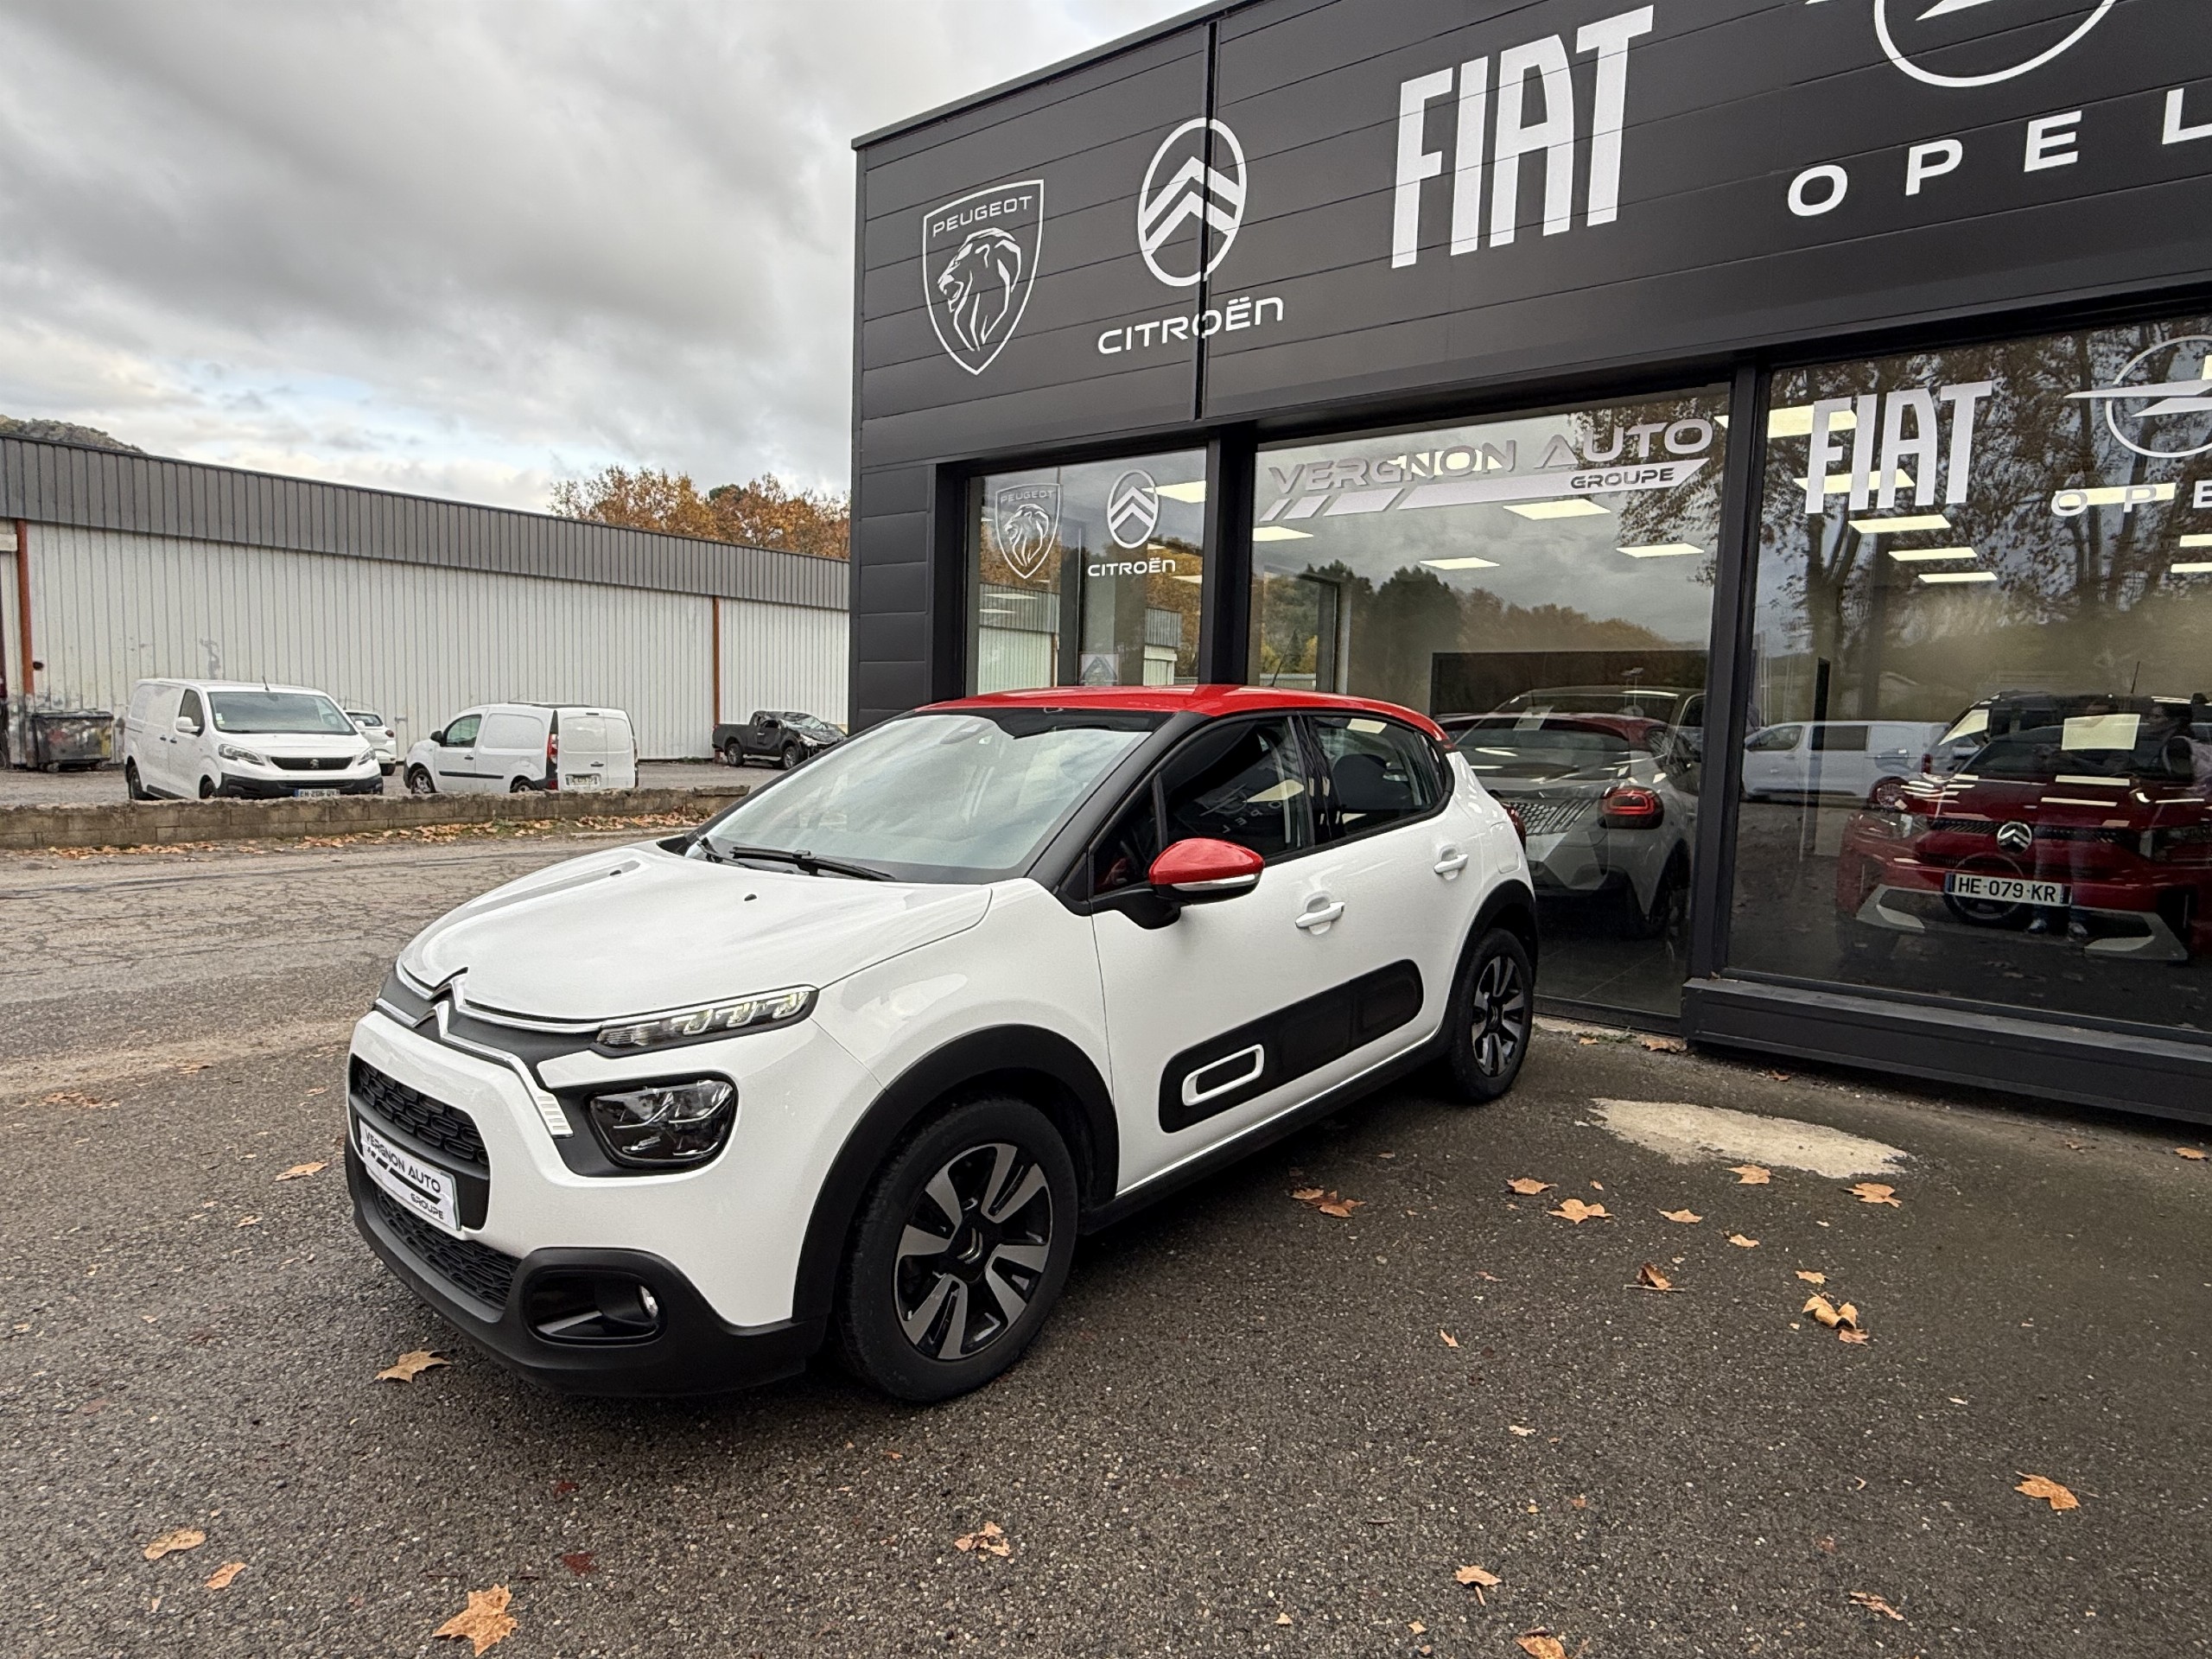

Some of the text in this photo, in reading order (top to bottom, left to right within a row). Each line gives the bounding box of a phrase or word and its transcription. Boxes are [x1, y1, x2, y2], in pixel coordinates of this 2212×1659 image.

[1391, 5, 1653, 268] FIAT
[1787, 87, 2212, 216] OPEL
[932, 195, 1033, 237] PEUGEOT
[1268, 418, 1713, 494] VERGNON AUTO
[1805, 380, 1993, 514] FIAT
[1000, 489, 1055, 503] PEUGEOT
[1570, 467, 1675, 489] GROUPE
[1958, 877, 2056, 902] HE-079-KR
[365, 1129, 442, 1193] VERGNON AUTO
[410, 1192, 444, 1220] GROUPE
